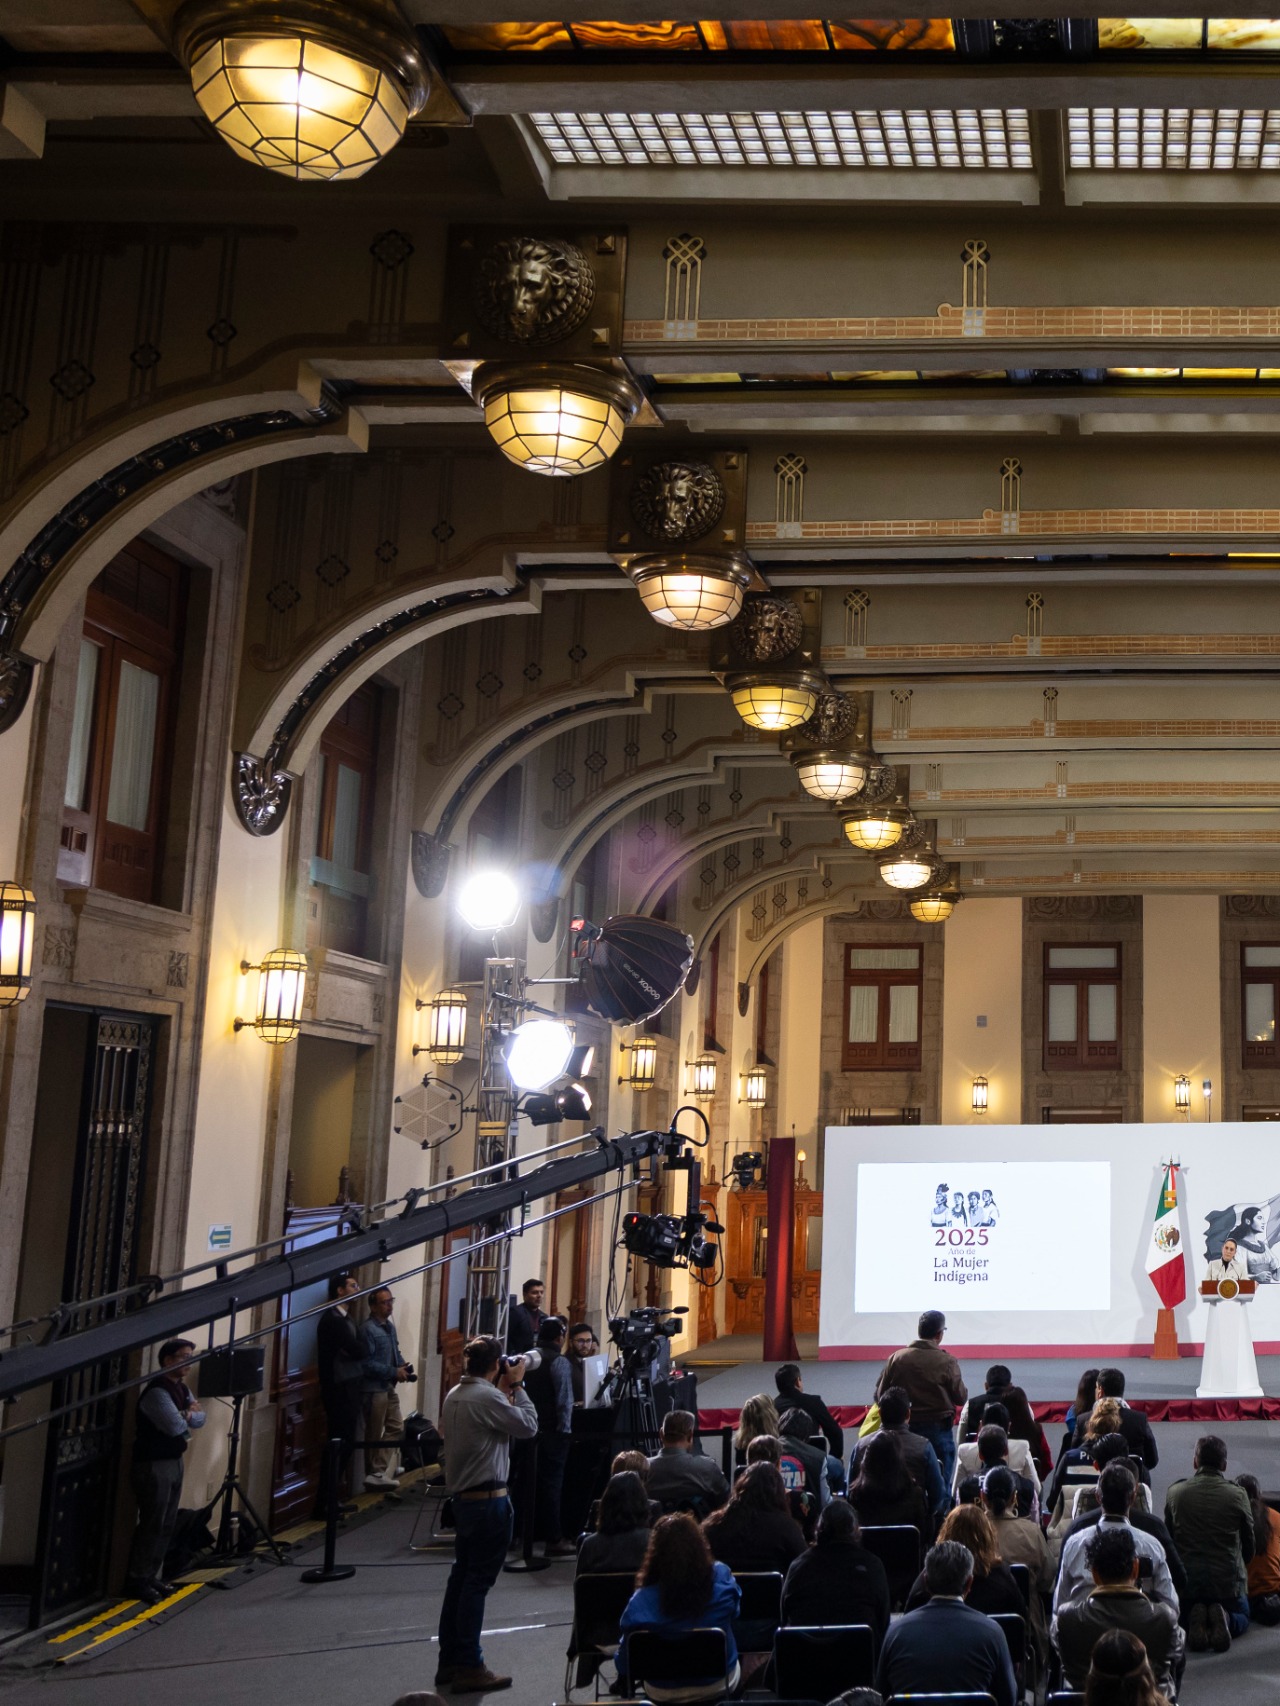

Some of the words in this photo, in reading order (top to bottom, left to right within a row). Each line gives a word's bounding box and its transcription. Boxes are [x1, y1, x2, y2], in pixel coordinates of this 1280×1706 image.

[935, 1228, 989, 1246] 2025
[966, 1247, 976, 1255] de
[934, 1257, 948, 1268] La
[953, 1257, 989, 1270] Mujer
[934, 1270, 988, 1285] Indígena
